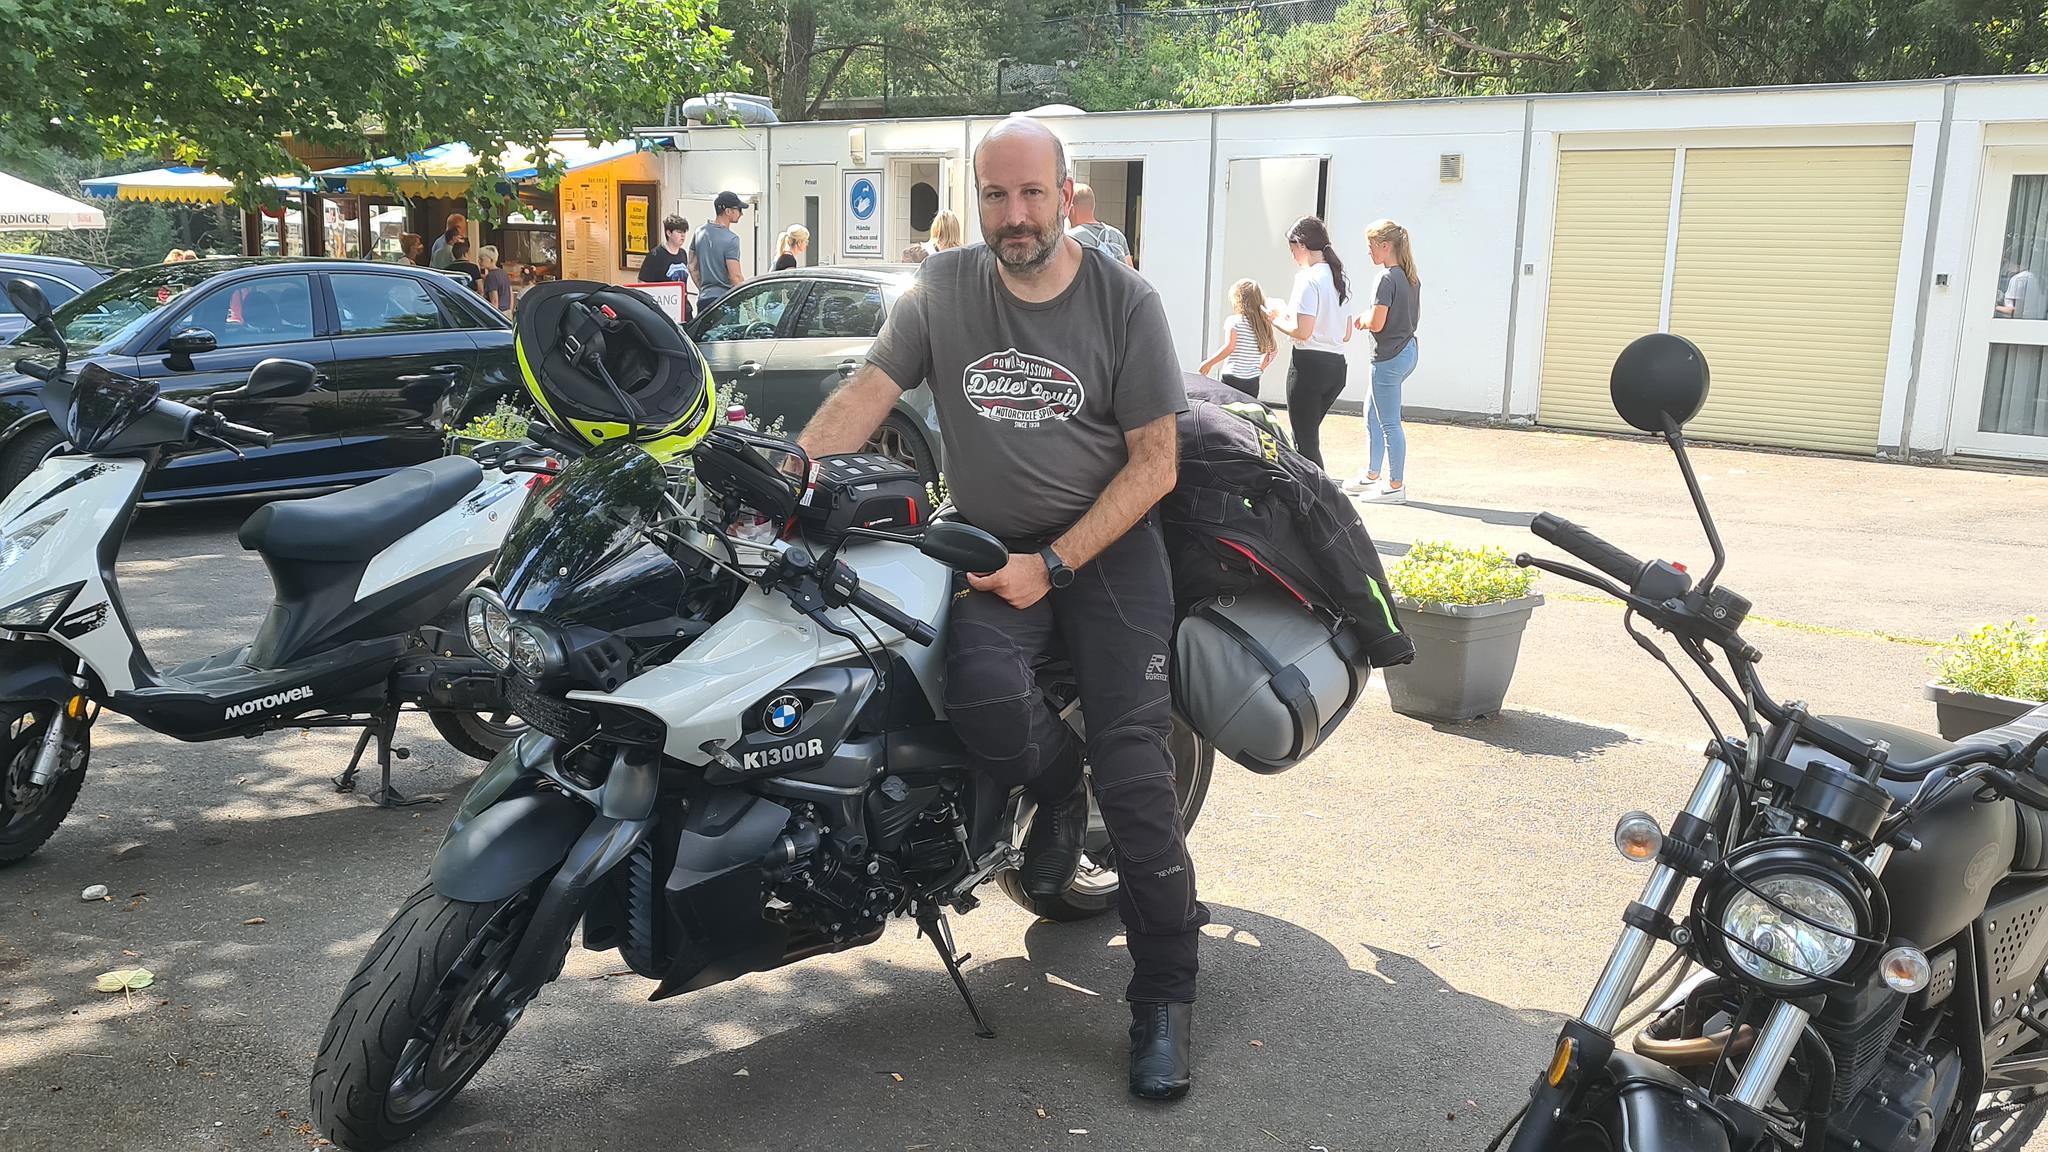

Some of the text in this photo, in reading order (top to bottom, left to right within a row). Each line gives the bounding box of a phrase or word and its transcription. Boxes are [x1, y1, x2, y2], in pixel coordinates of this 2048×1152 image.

[996, 407, 1037, 420] MOTORCYCLE
[767, 697, 800, 714] BMW
[743, 738, 824, 770] K1300R
